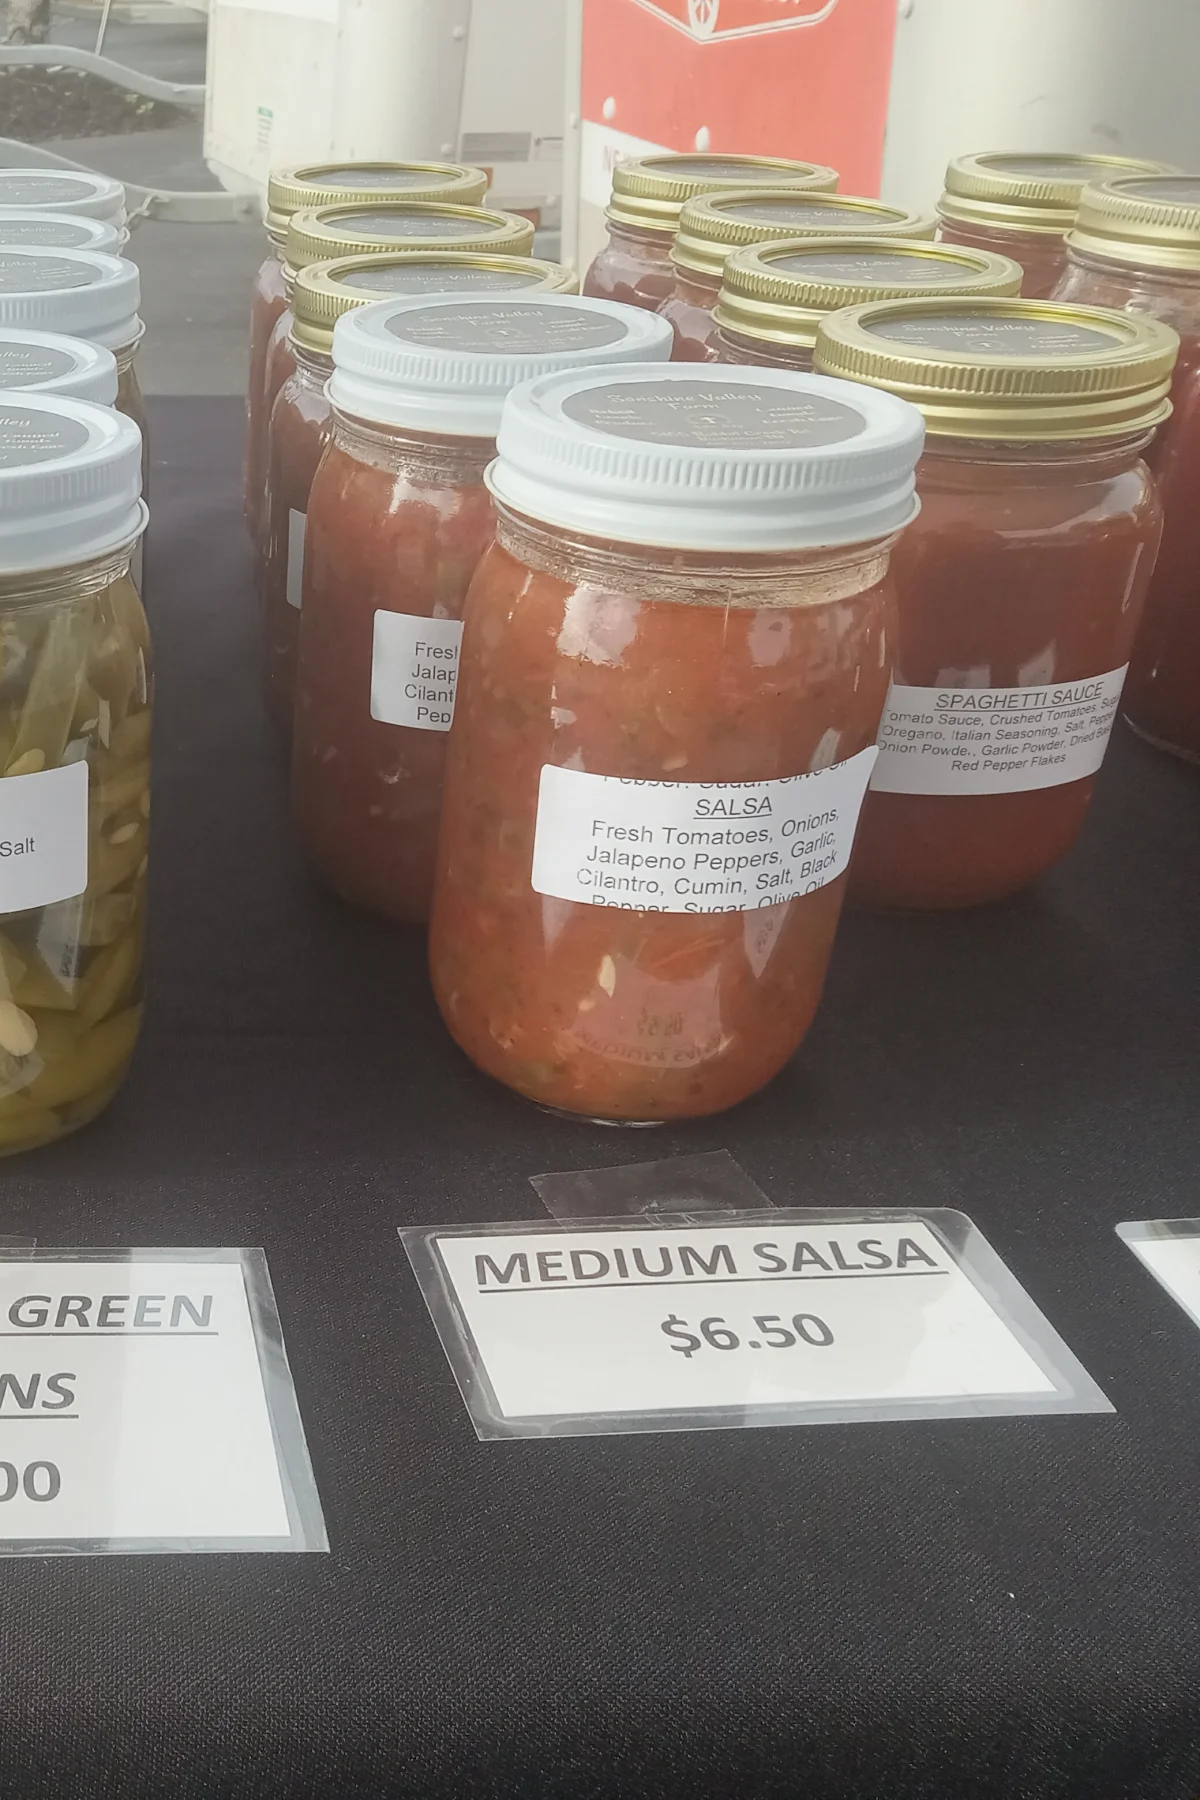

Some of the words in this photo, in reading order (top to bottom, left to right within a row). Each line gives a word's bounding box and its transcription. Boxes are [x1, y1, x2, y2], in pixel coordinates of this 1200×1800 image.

[936, 692, 1048, 709] SPAGHETTI
[1051, 681, 1105, 705] SAUCE
[887, 709, 933, 724] omato
[938, 713, 984, 727] Sauce,
[990, 712, 1043, 726] Crushed
[951, 730, 991, 741] Italian
[981, 744, 1019, 756] Garlic
[1069, 730, 1095, 747] Dried
[951, 760, 980, 771] Red
[982, 757, 1028, 773] Pepper
[1030, 753, 1067, 768] Flakes
[695, 796, 773, 816] SALSA
[591, 820, 653, 843] Fresh
[662, 827, 773, 846] Tomatoes,
[781, 807, 840, 838] Onions,
[0, 837, 35, 857] Salt
[586, 845, 686, 870] Jalapeno
[693, 850, 784, 874] Peppers,
[790, 829, 836, 859] Garlic,
[576, 868, 665, 896] Cilantro,
[674, 877, 748, 896] Cumin,
[756, 867, 794, 892] Salt,
[800, 851, 838, 880] Black
[474, 1244, 738, 1285] MEDIUM
[753, 1237, 938, 1272] SALSA
[8, 1294, 213, 1328] GREEN
[660, 1313, 835, 1358] $6.50
